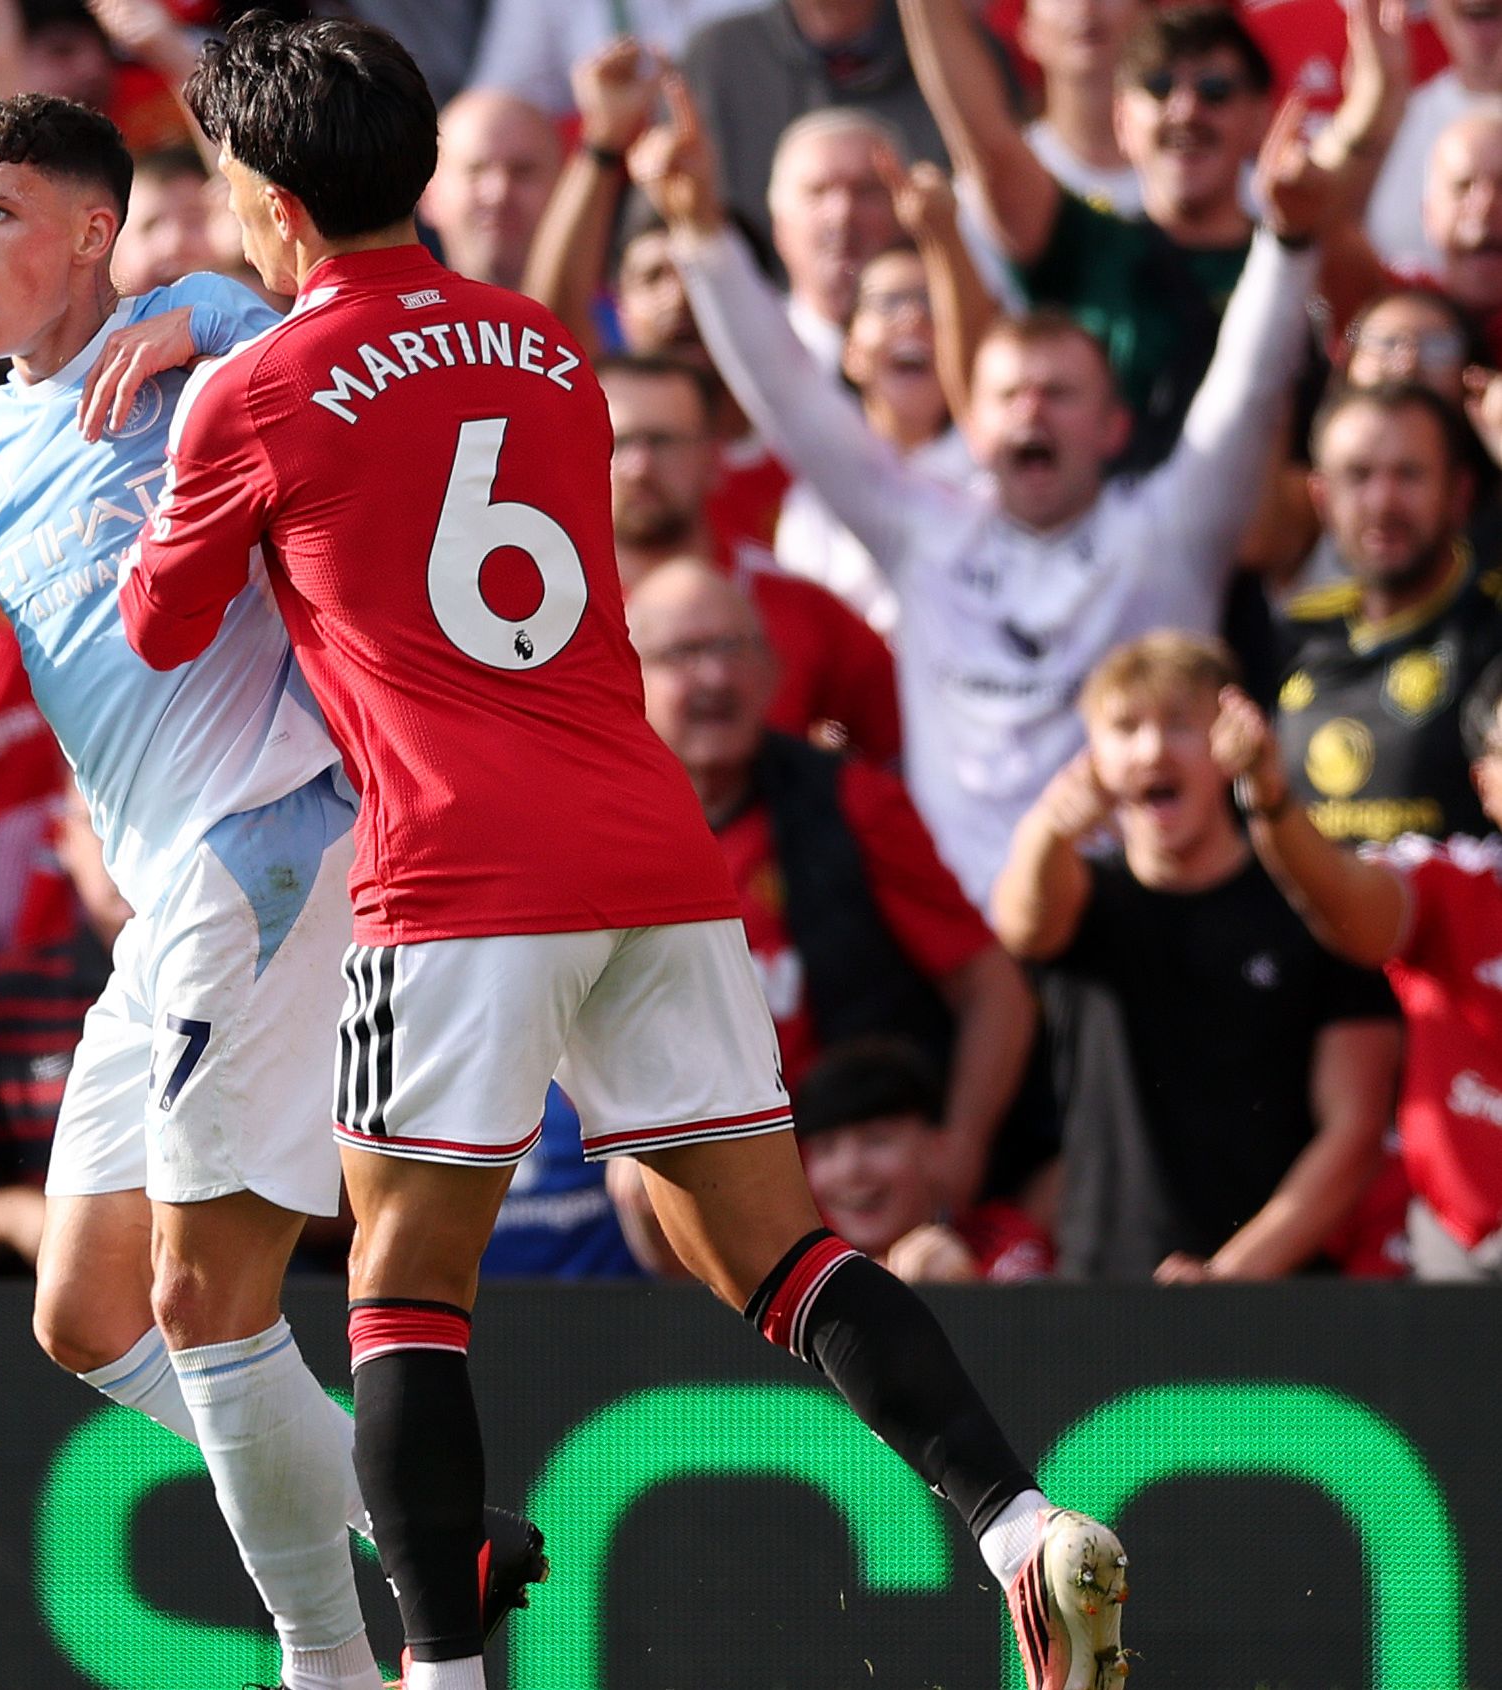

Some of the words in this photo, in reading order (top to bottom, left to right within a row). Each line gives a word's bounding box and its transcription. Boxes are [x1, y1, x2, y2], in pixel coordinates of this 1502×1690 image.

[397, 289, 446, 309] UNITED
[311, 320, 580, 424] MARTINEZ
[426, 418, 588, 670] 6
